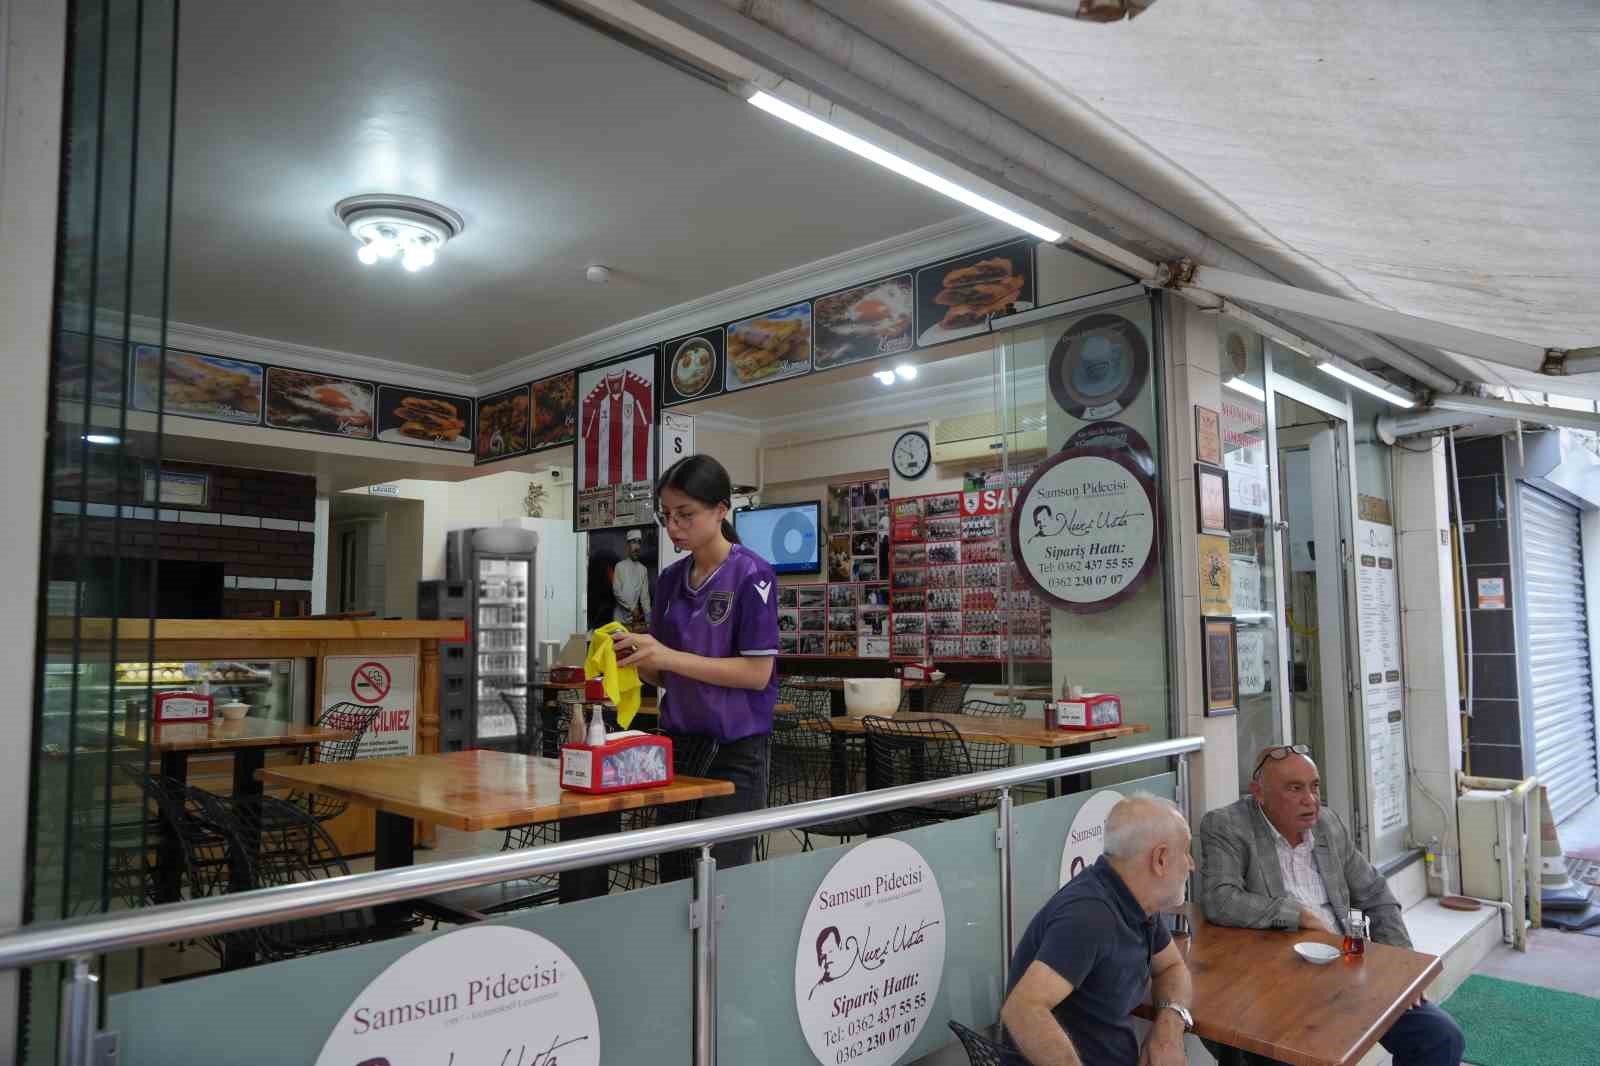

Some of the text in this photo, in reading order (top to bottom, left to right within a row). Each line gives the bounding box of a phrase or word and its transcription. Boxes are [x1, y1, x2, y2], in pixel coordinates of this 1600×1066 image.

[1037, 485, 1079, 499] Samsun
[1082, 479, 1127, 495] Pidecisi
[1044, 544, 1085, 560] Sipariş
[1057, 561, 1082, 572] 0362
[1085, 560, 1102, 571] 437
[1105, 558, 1118, 569] 55
[1121, 557, 1134, 568] 55
[1048, 574, 1123, 588] 0362 230 07 07
[1071, 825, 1102, 843] Samsun
[819, 882, 872, 910] Samsun
[875, 865, 922, 895] Pidecisi
[353, 993, 458, 1036] Samsun
[468, 960, 560, 1007] Pidecisi
[831, 972, 919, 1018] Sipariş Hattı:
[824, 992, 927, 1047] Tel: 0362 437 55 55
[836, 1018, 917, 1065] 0362 230 07 07
